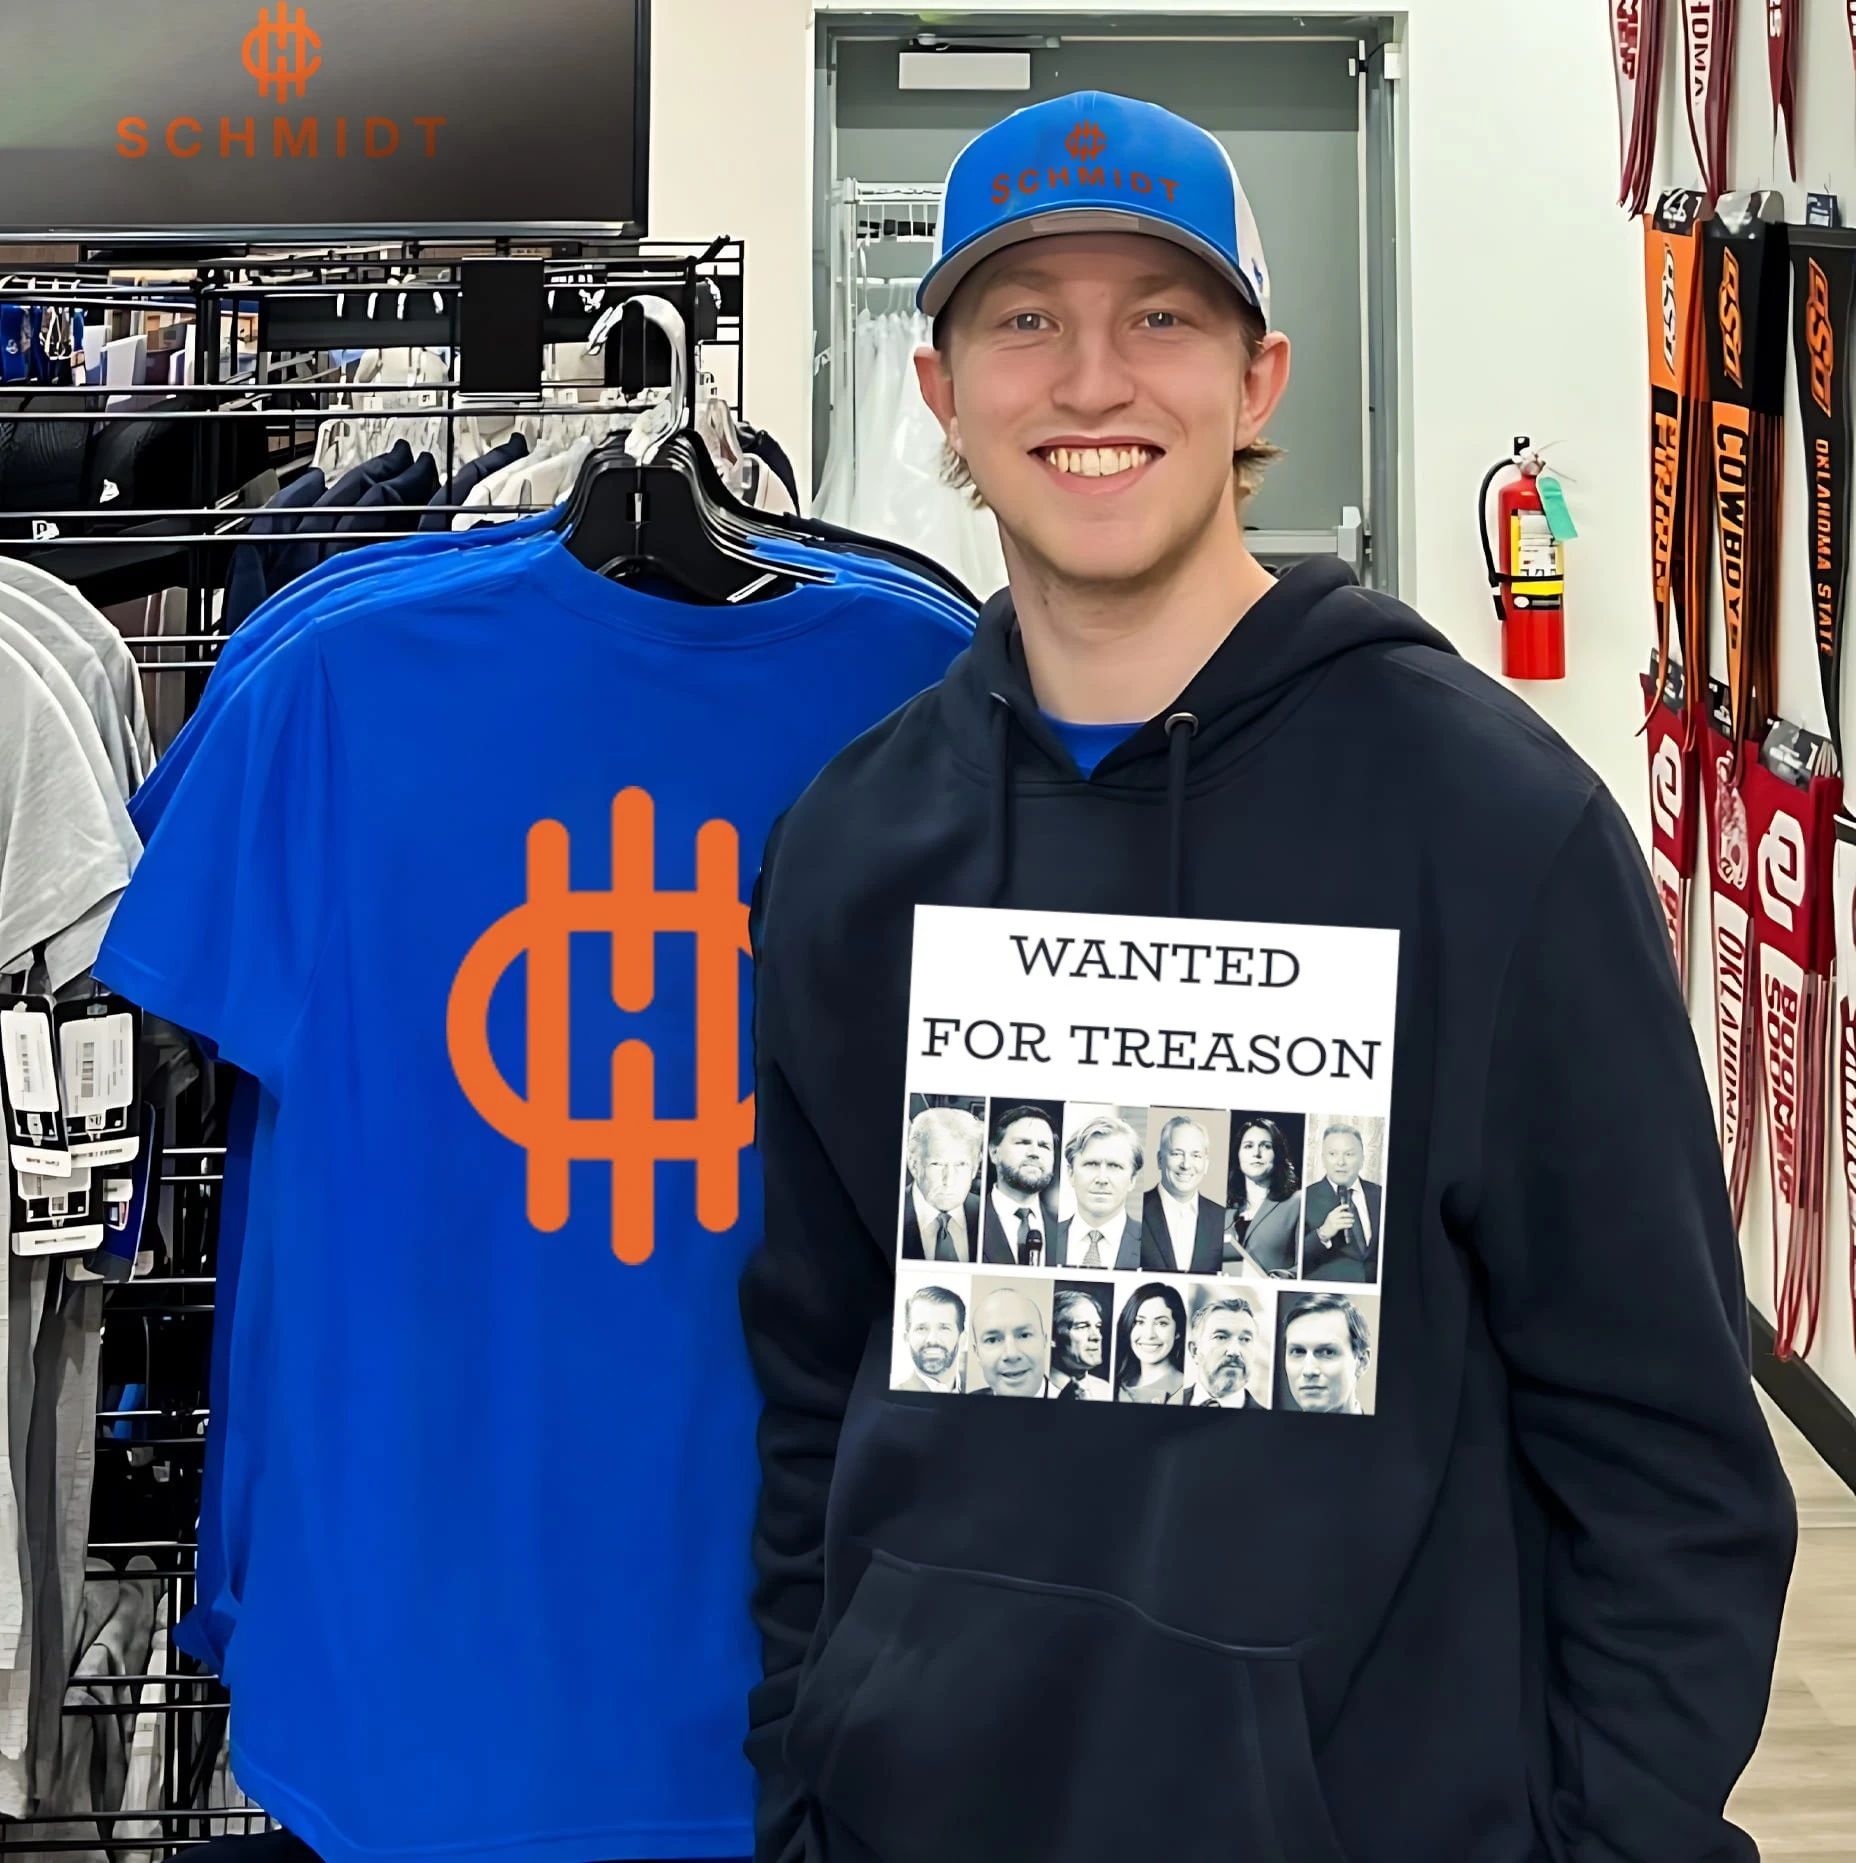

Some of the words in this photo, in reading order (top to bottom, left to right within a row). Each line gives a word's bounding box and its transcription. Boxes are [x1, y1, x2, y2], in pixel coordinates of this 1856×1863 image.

[116, 116, 447, 159] SCHMIDT
[991, 166, 1181, 204] SCHMIDT
[1009, 934, 1301, 989] WANTED
[920, 1017, 1052, 1063] FOR
[1069, 1024, 1382, 1080] TREASON
[1718, 926, 1745, 1144] OKLAHOMA
